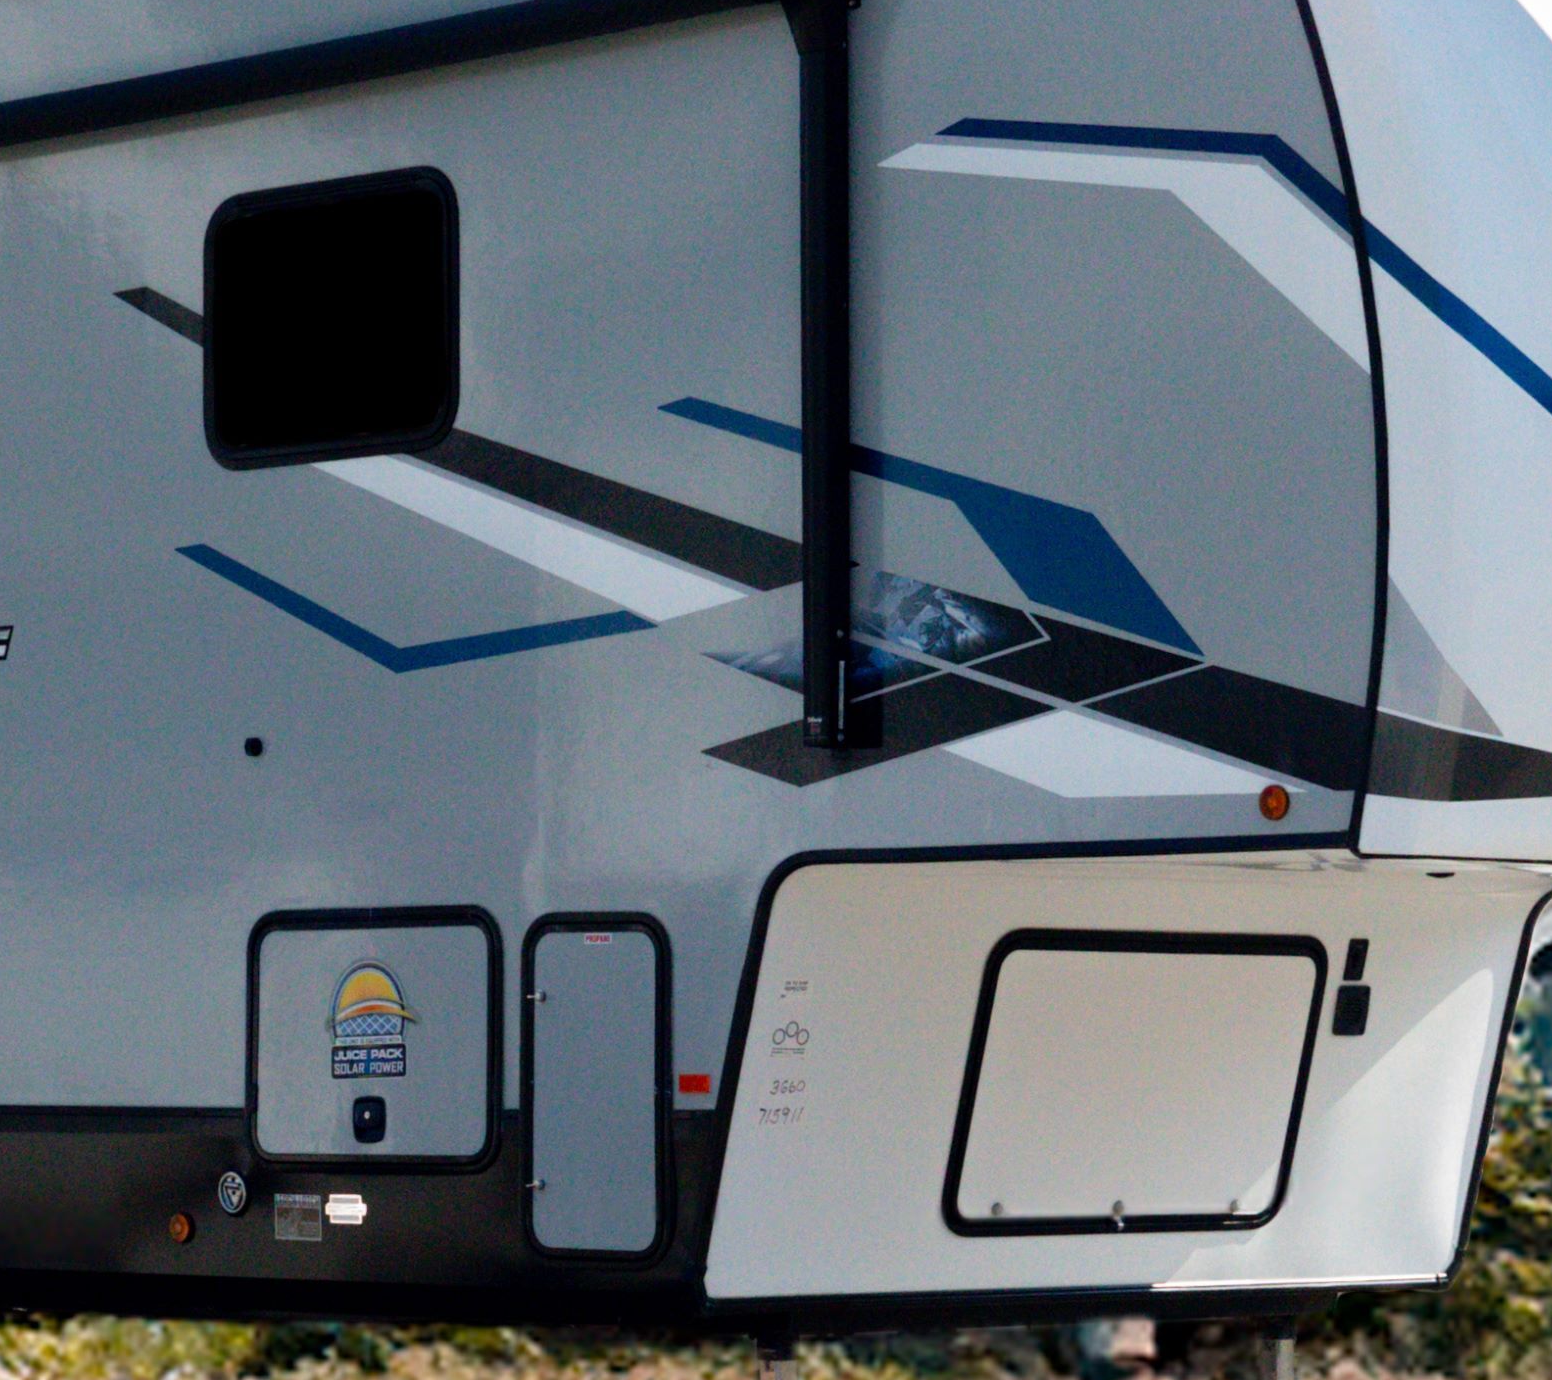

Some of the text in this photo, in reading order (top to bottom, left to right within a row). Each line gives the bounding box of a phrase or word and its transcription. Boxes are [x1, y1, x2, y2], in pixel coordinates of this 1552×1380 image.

[334, 1048, 403, 1061] JUICE PACK
[334, 1061, 404, 1075] SOLAR POWER
